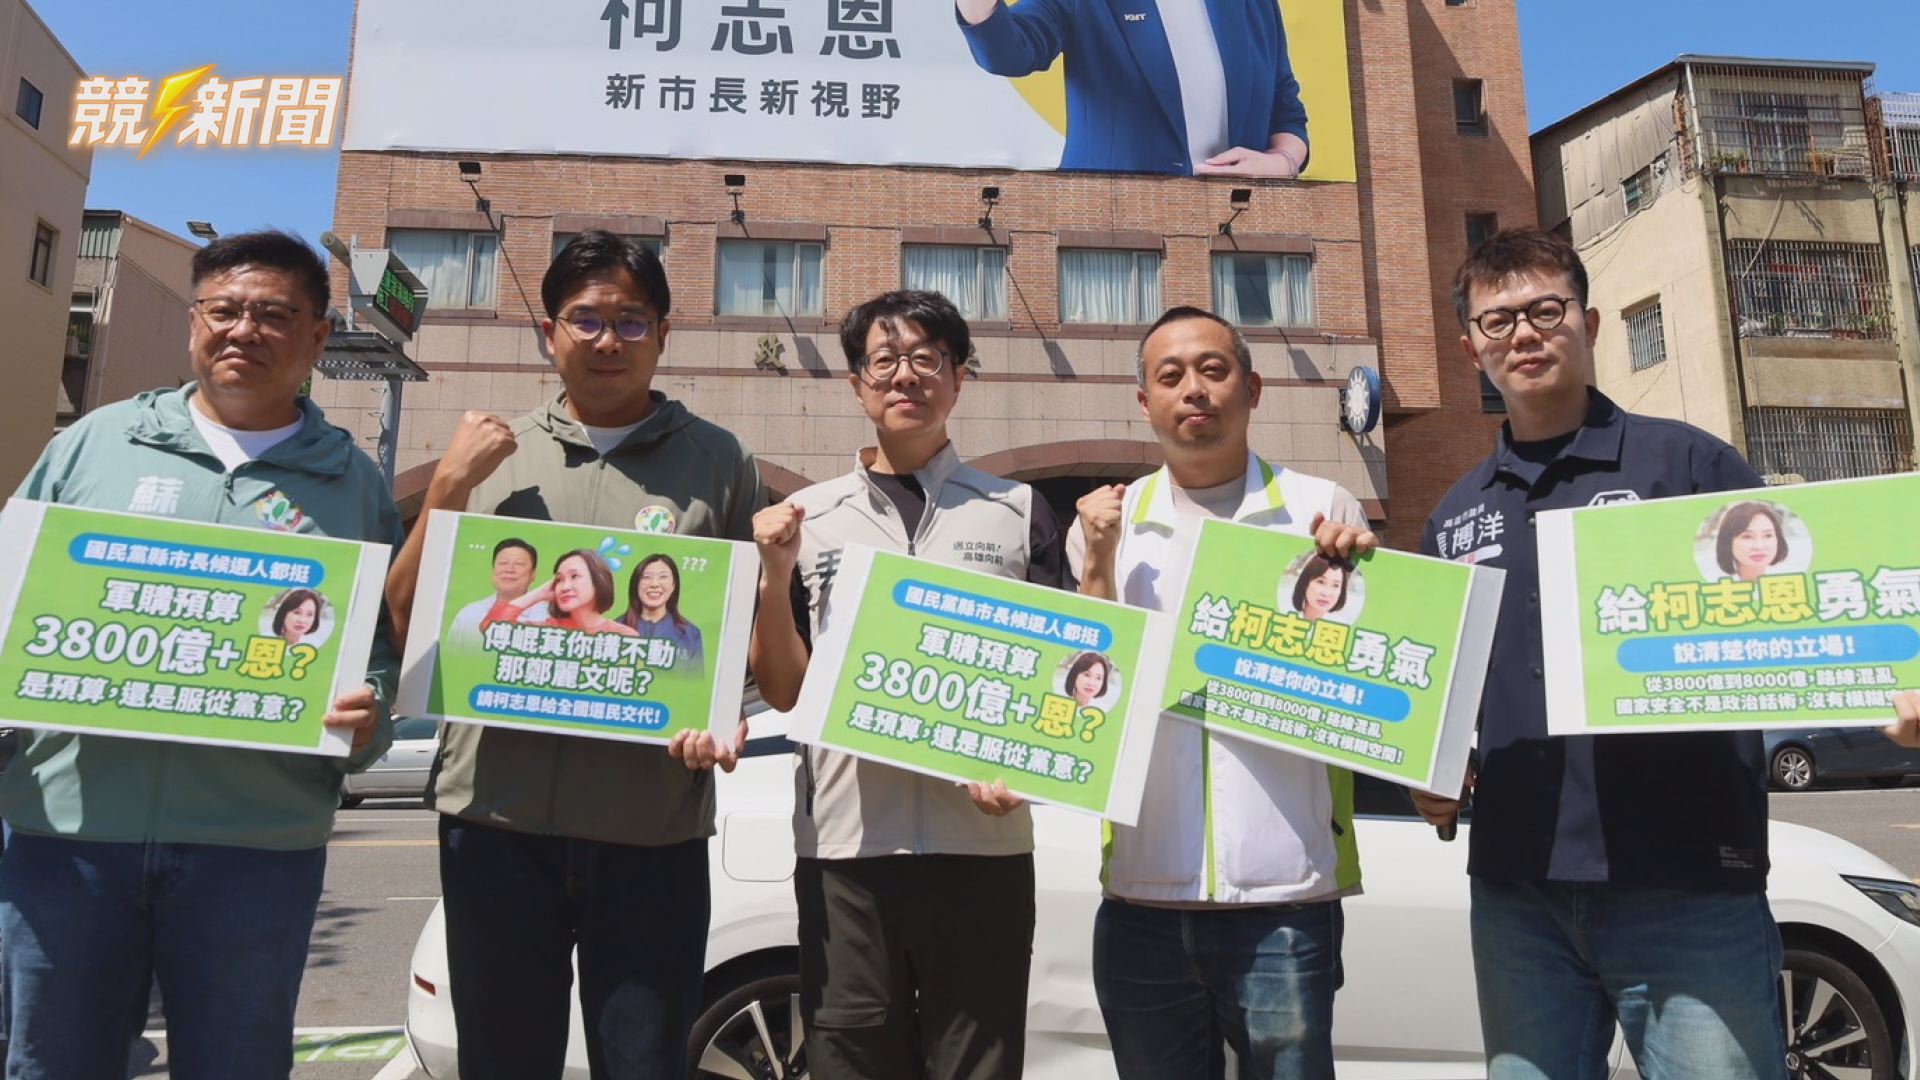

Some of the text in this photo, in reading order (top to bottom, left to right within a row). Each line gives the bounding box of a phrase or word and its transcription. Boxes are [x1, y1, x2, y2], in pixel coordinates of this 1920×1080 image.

[605, 73, 901, 119] 新市長新視野
[84, 540, 310, 583] 國民黨縣市長候選人都挺
[101, 579, 244, 624] 軍購預算
[905, 586, 1100, 647] 國民黨縣市長候選人都挺
[1597, 567, 1920, 633] 給柯志恩勇氣
[25, 615, 318, 680] 3800億+恩？
[917, 625, 1040, 678] 軍購預算
[1190, 593, 1435, 688] 給柯志恩勇氣
[1673, 634, 1855, 664] 說清楚你的立場！
[17, 671, 304, 723] 是預算，還是服從黨意？
[496, 656, 654, 695] 那鄭麗文呢？
[856, 654, 1104, 743] 3800億+恩？
[1234, 657, 1364, 706] 說清楚你的立場！
[477, 690, 661, 724] 請柯志恩給全國選民交代！
[848, 703, 1093, 784] 是預算，還是服從黨意？
